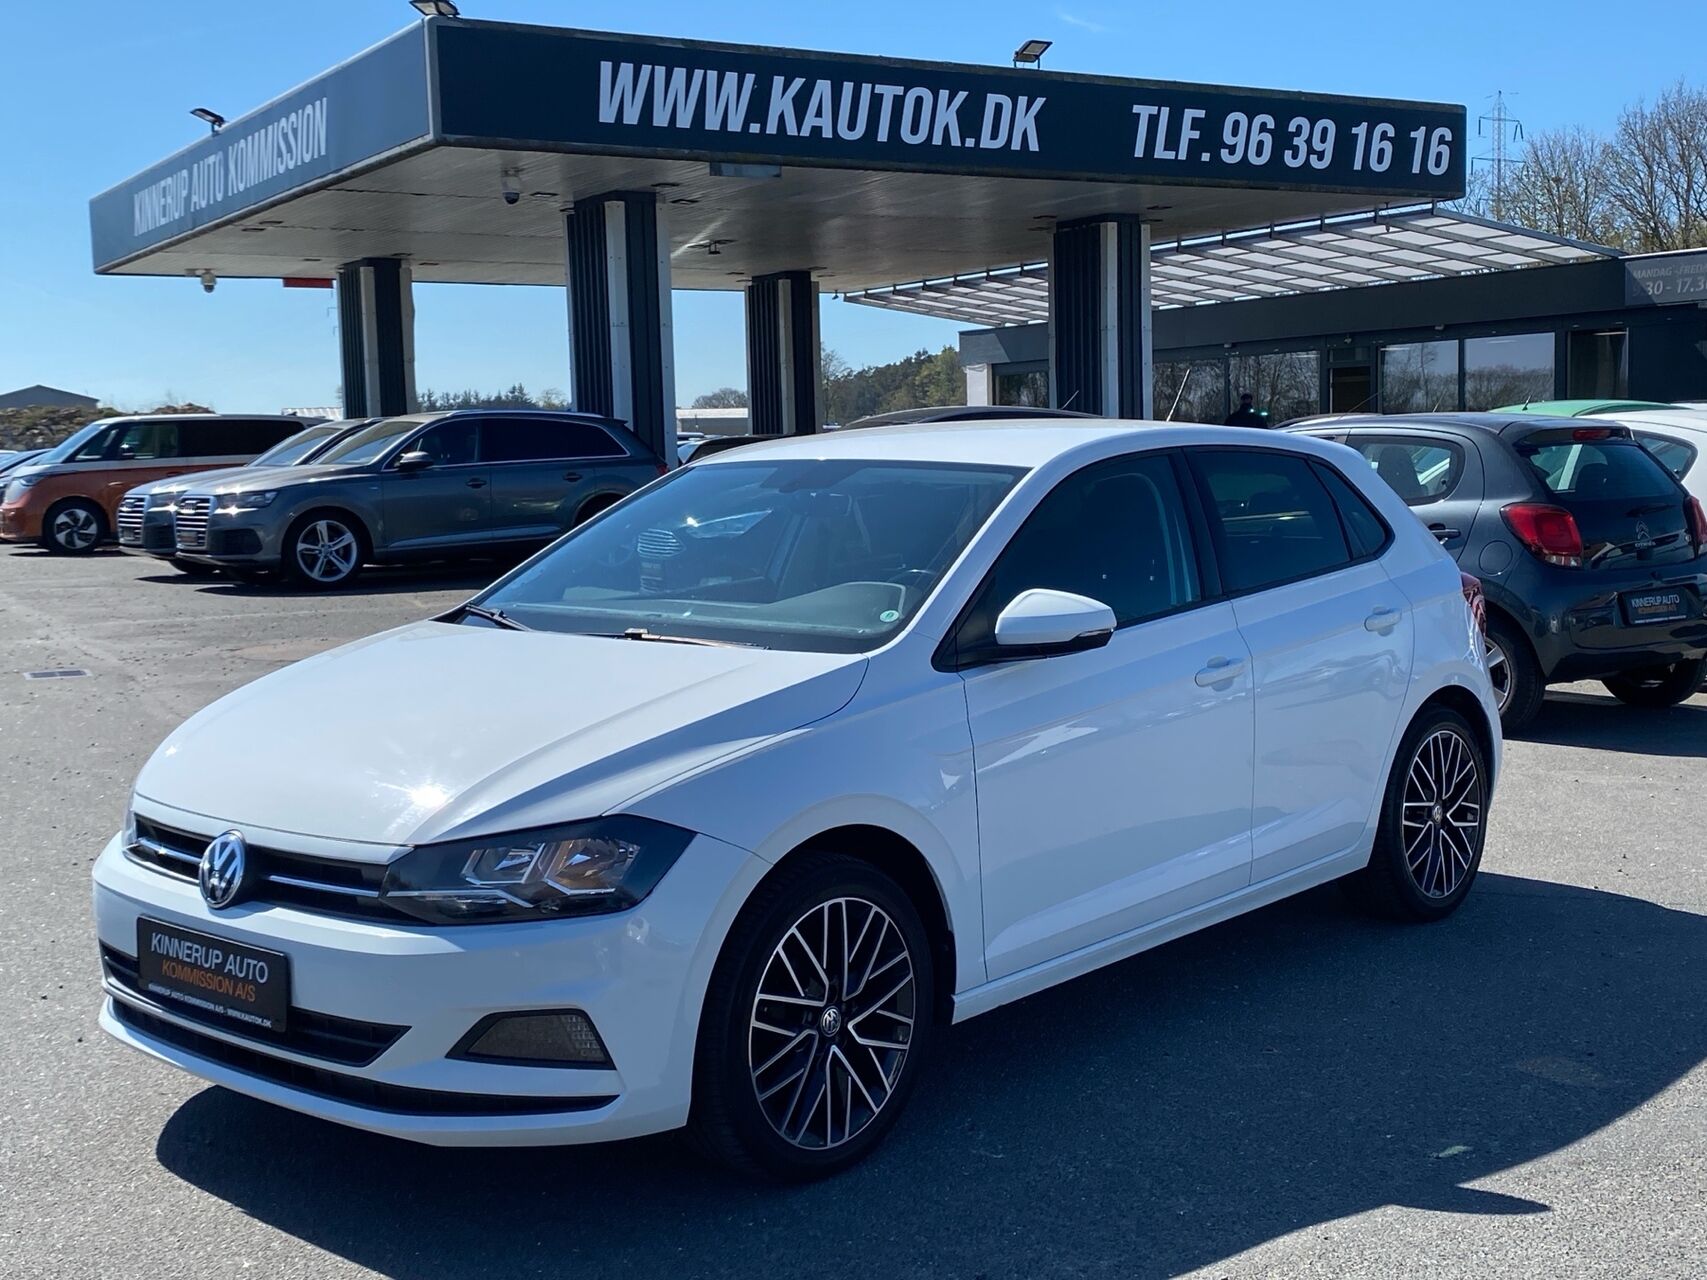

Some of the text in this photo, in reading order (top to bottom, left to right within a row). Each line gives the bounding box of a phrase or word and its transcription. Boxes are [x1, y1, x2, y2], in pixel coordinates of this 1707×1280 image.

[599, 60, 1453, 176] WWW.KAUTOK.DK TLF. 96 39 16 16
[133, 97, 328, 236] KINNERUP AUTO KOMMISSION
[1633, 266, 1672, 279] MANDAG
[1662, 594, 1680, 605] AUTO
[151, 932, 269, 983] KINNERUP AUTO
[162, 959, 256, 1003] KOMMISSION A/S
